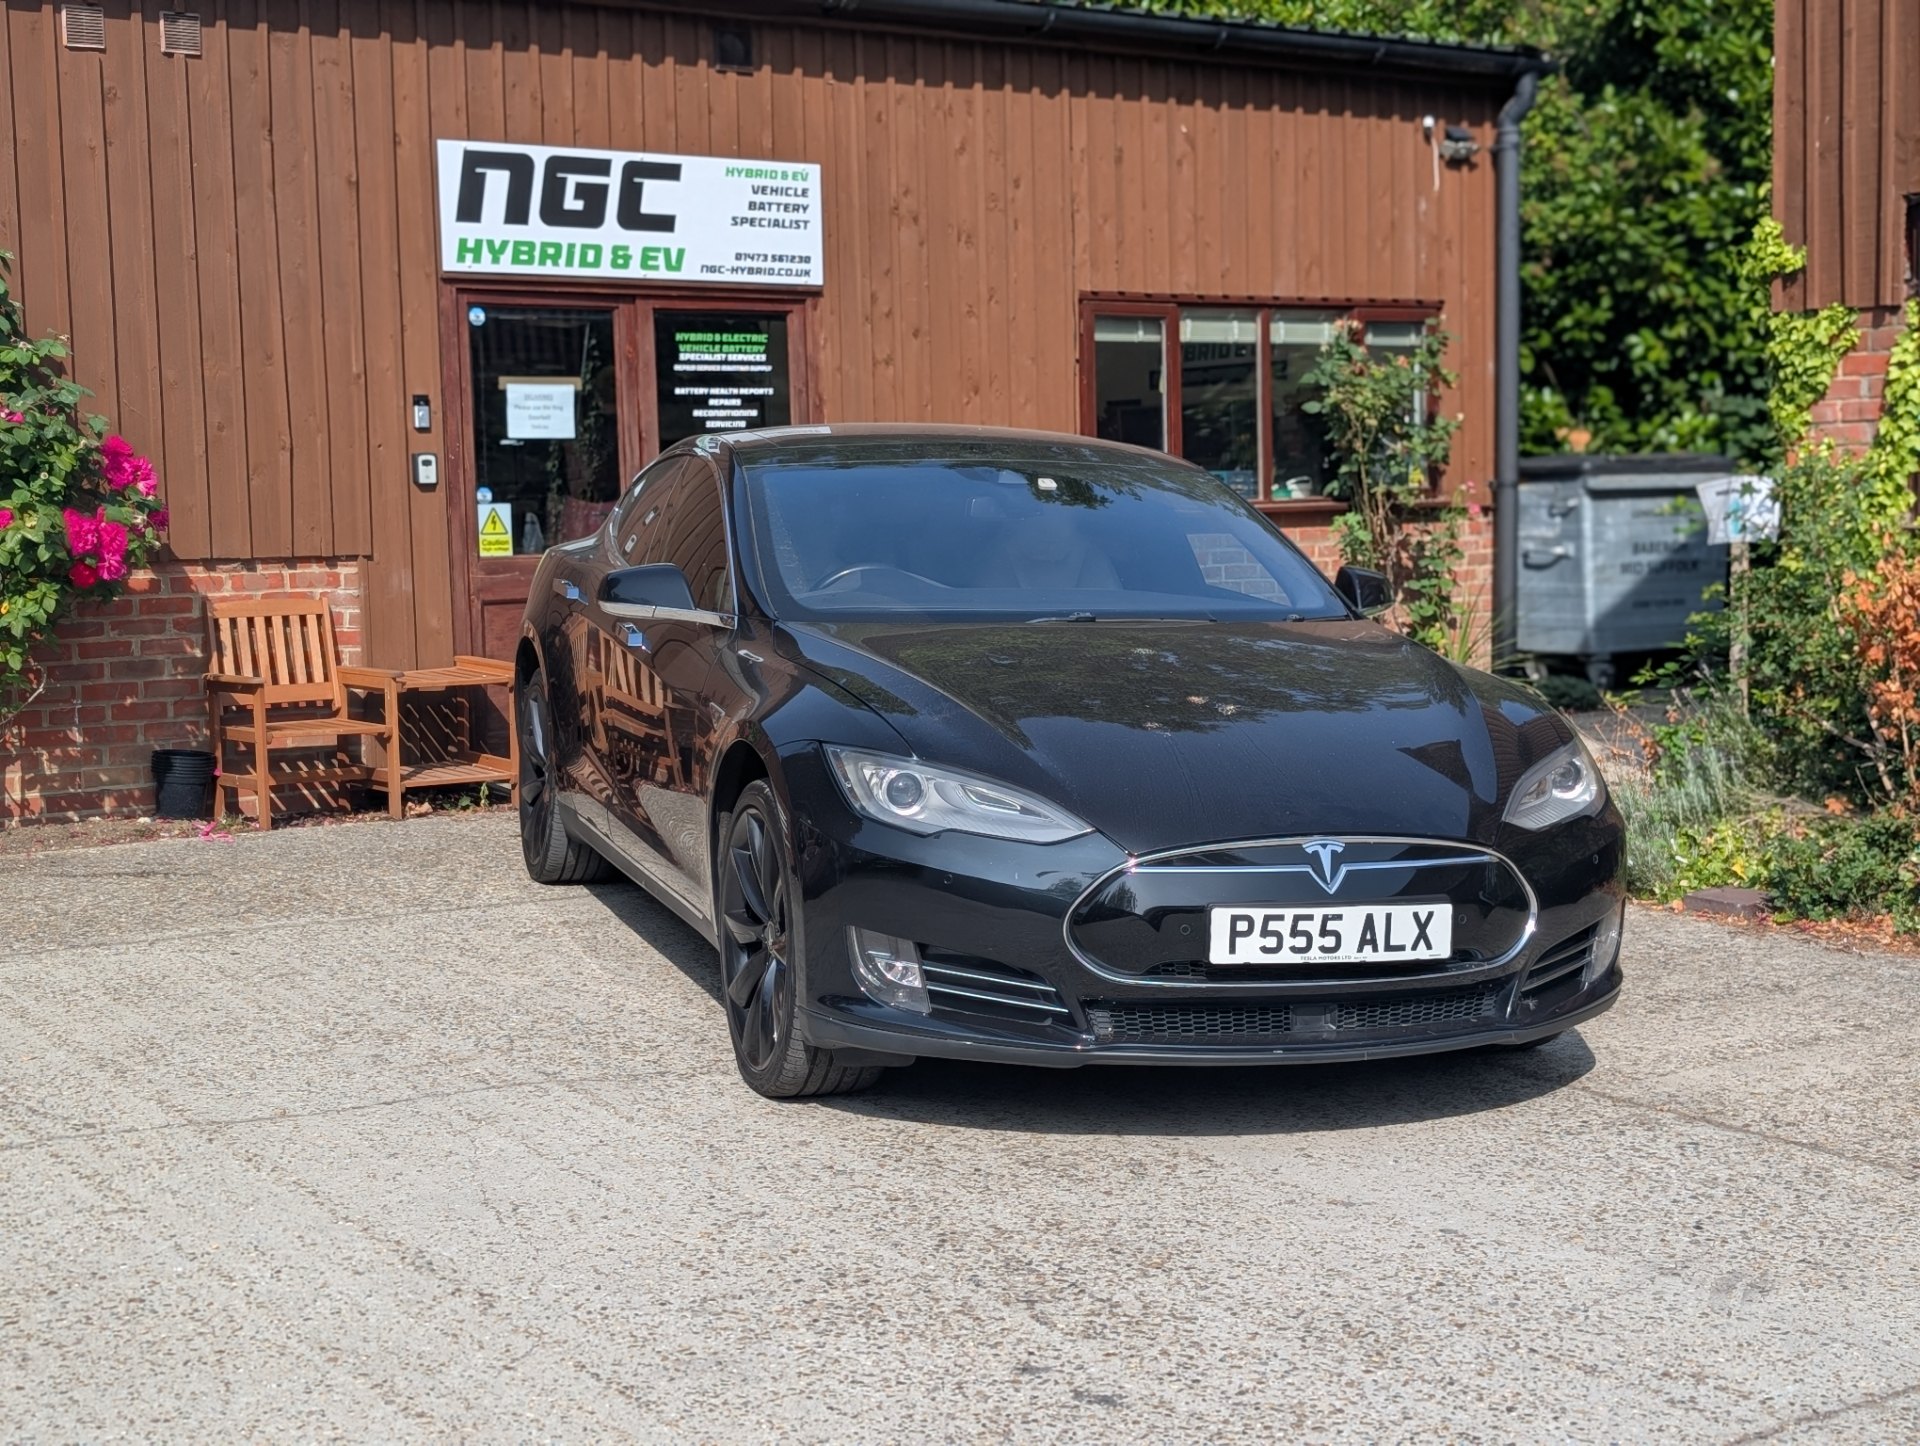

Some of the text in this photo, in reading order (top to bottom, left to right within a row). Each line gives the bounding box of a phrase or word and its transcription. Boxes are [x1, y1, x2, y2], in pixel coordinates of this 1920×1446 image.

[725, 166, 810, 183] HYBRID & EV
[455, 149, 683, 233] NGC
[751, 185, 809, 198] VEHICLE
[748, 201, 809, 214] BATTERY
[731, 216, 810, 230] SPECIALIST
[456, 238, 686, 272] HYBRID & EV
[735, 251, 768, 263] 01473
[700, 265, 811, 278] NGC-HYBRID.CO.UK
[675, 332, 713, 342] HYBRID
[722, 333, 769, 343] ELECTRIC
[678, 344, 766, 353] VEHICLE BATTERY
[678, 353, 767, 363] SPECIALIST SERVICES
[674, 387, 774, 395] BATTERY HEALTH REPORTS
[708, 398, 742, 406] REPAIRS
[705, 420, 747, 429] SERVICING
[1229, 911, 1435, 955] P555 ALX
